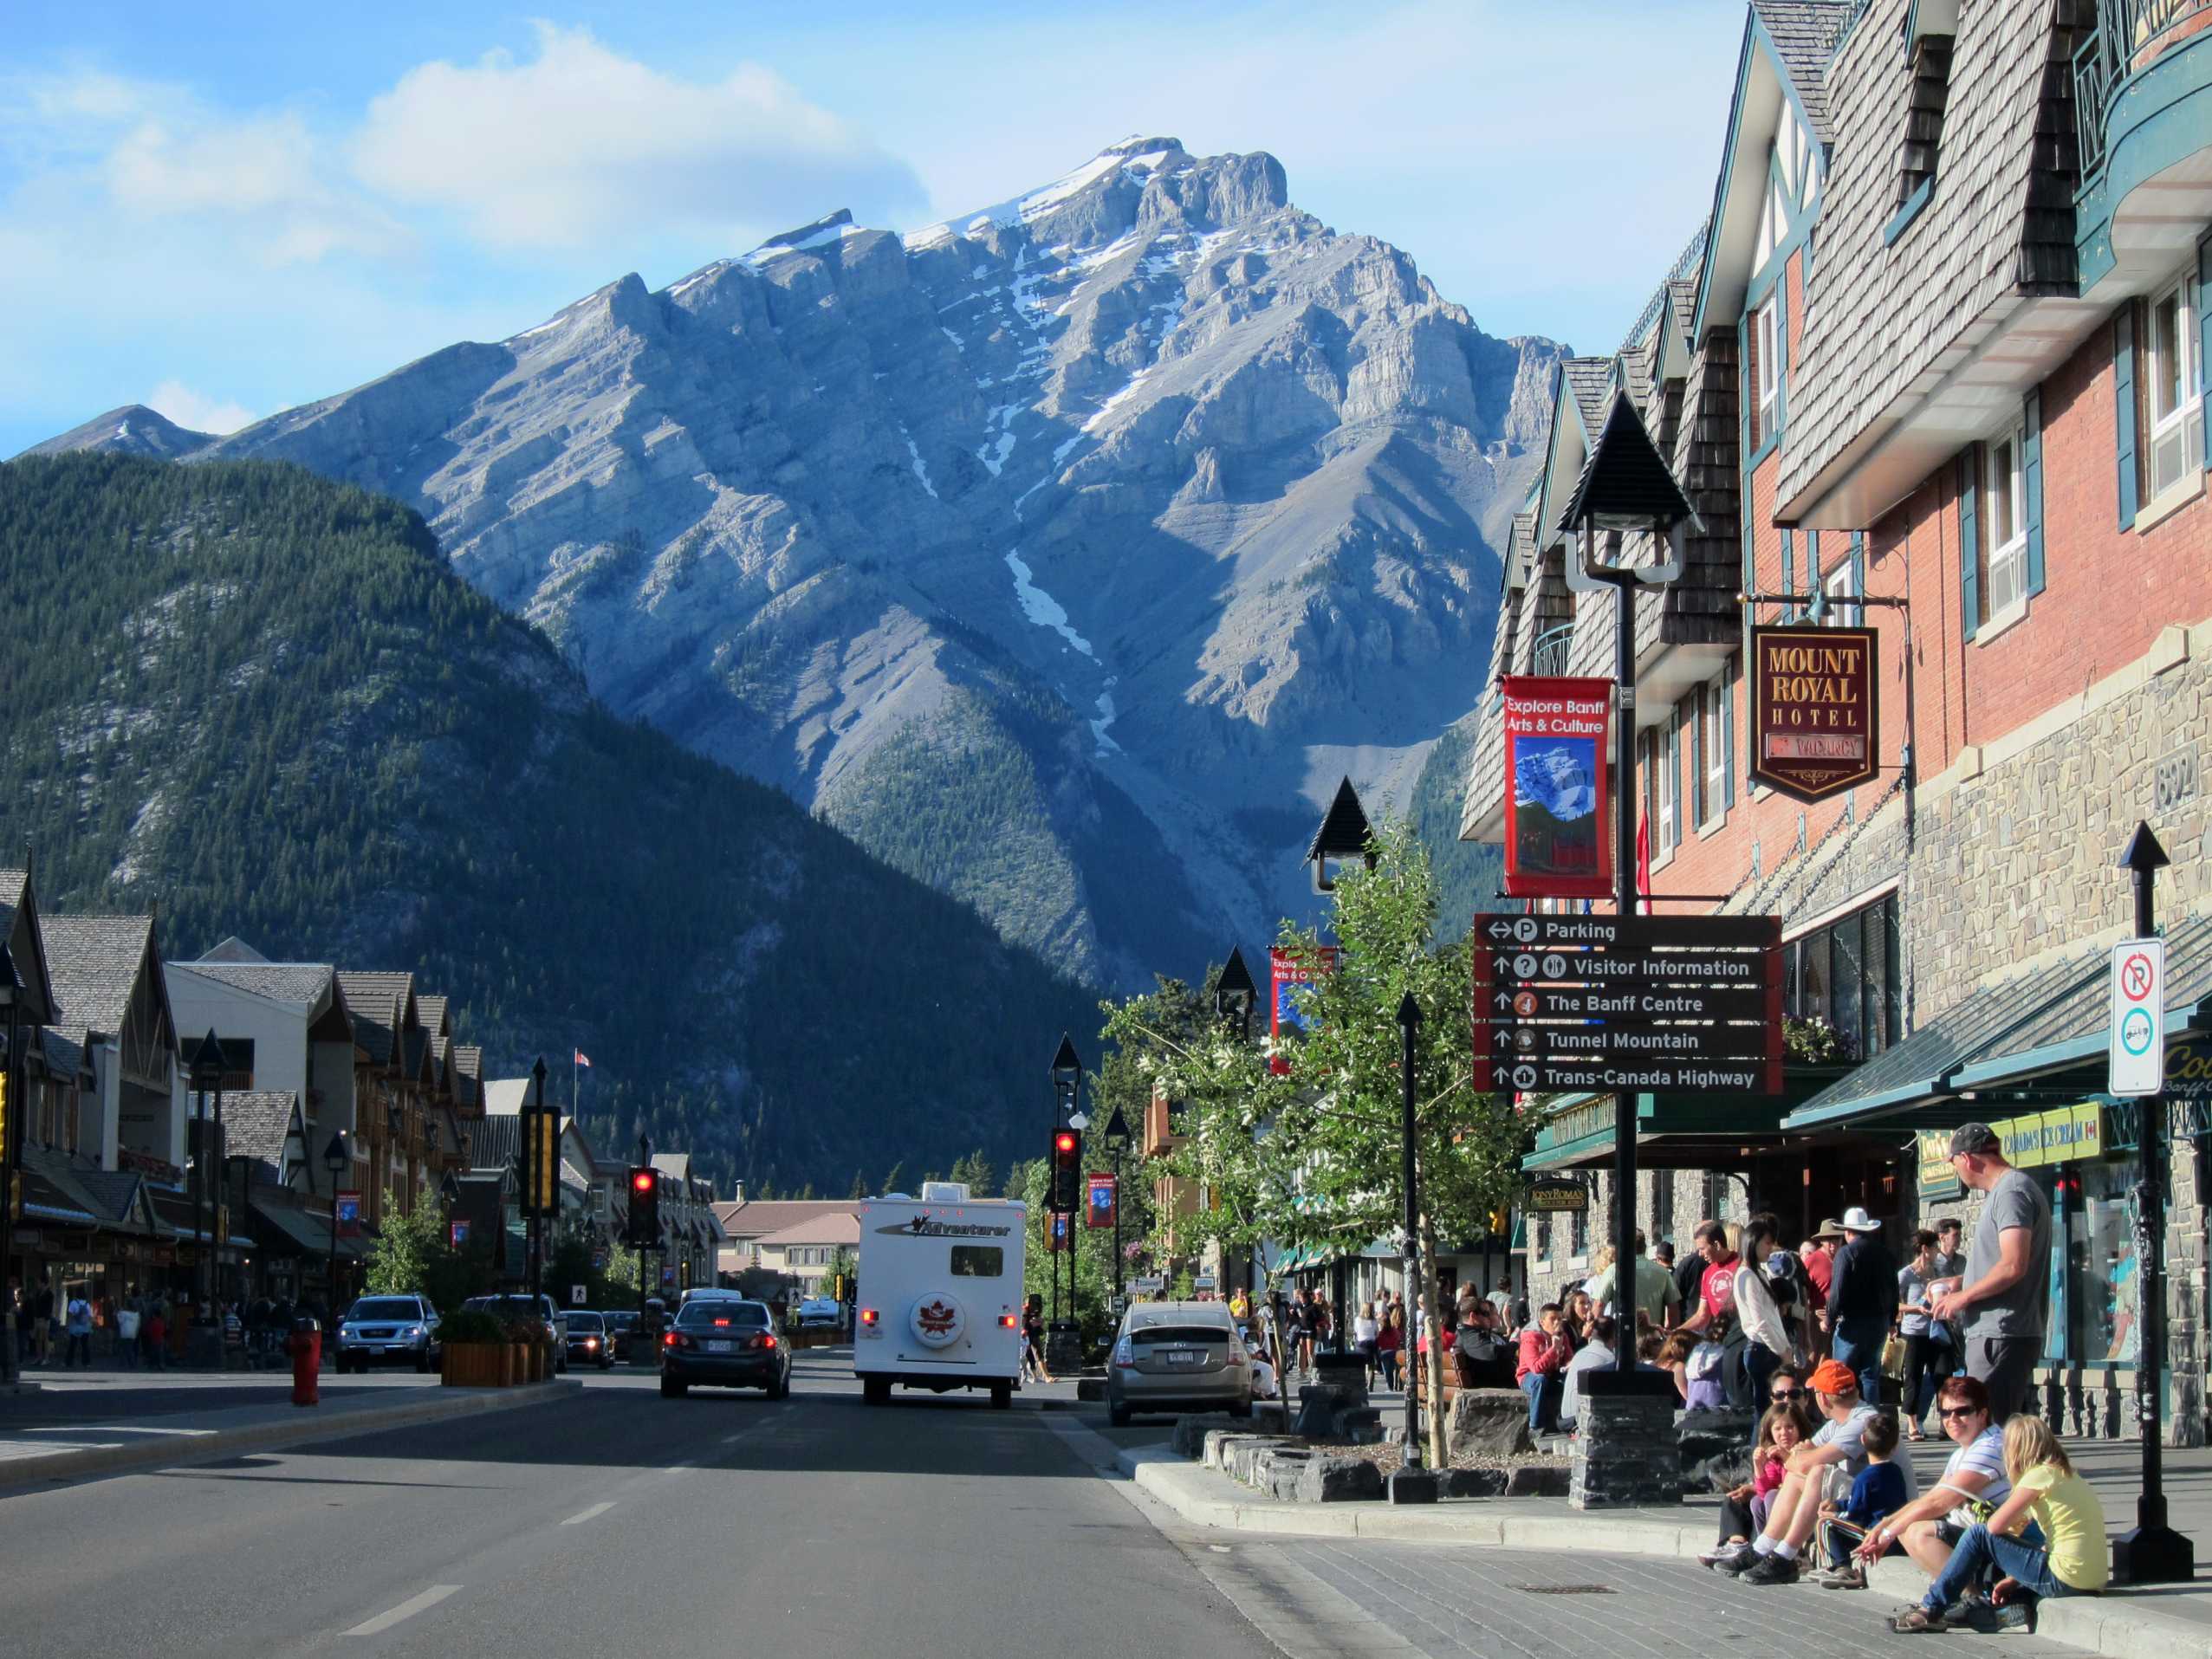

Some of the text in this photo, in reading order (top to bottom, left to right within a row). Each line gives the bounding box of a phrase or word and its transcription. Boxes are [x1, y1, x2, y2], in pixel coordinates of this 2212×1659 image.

[1768, 647, 1859, 674] MOUNT
[1771, 677, 1857, 703] ROYAL
[1508, 699, 1605, 716] Explore Banff
[1508, 718, 1603, 733] Arts & Culture
[1772, 708, 1857, 726] HOTEL
[1796, 738, 1859, 757] VACANCY
[1546, 923, 1616, 942] Parking
[1274, 959, 1300, 969] Explo
[1574, 959, 1636, 975] Visitor
[1643, 960, 1749, 975] Information
[1274, 970, 1288, 980] Arts
[1547, 995, 1703, 1012] The Banff Centre
[1547, 1033, 1698, 1048] Tunnel Mountain
[1546, 1069, 1670, 1085] Trans-Canada
[1677, 1070, 1754, 1088] Highway
[922, 1222, 1011, 1237] Adventurer
